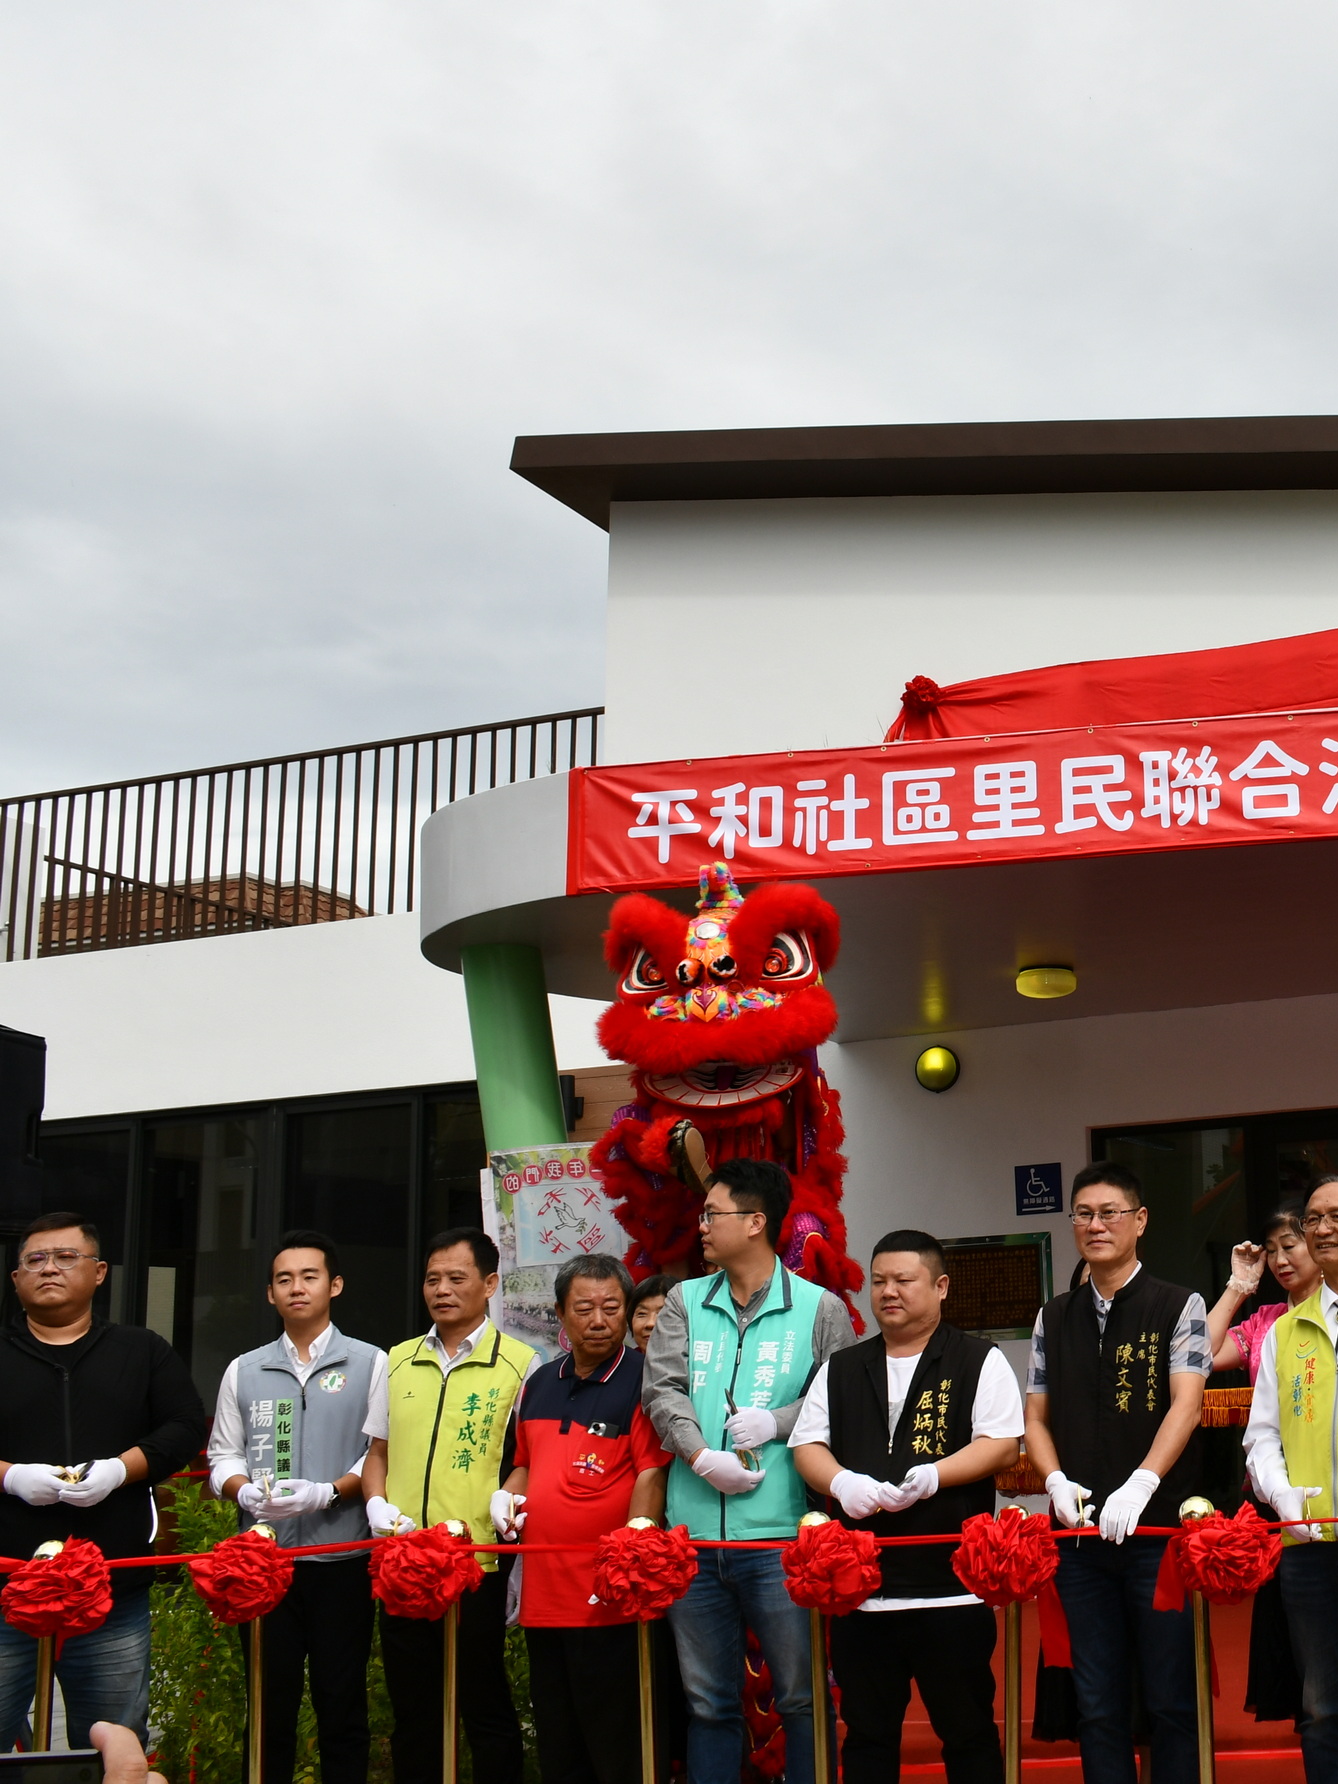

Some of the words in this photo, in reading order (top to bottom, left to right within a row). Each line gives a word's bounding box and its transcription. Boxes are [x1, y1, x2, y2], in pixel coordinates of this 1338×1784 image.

[780, 1330, 796, 1374] 立法委員
[1115, 1342, 1134, 1413] 陳文賓
[1136, 1331, 1147, 1360] 主席
[277, 1402, 292, 1480] 彰化縣議
[452, 1393, 481, 1473] 李成濟
[478, 1388, 500, 1456] 彰化縣議員
[911, 1390, 933, 1454] 屈炳秋
[935, 1379, 952, 1455] 彰化市民代表
